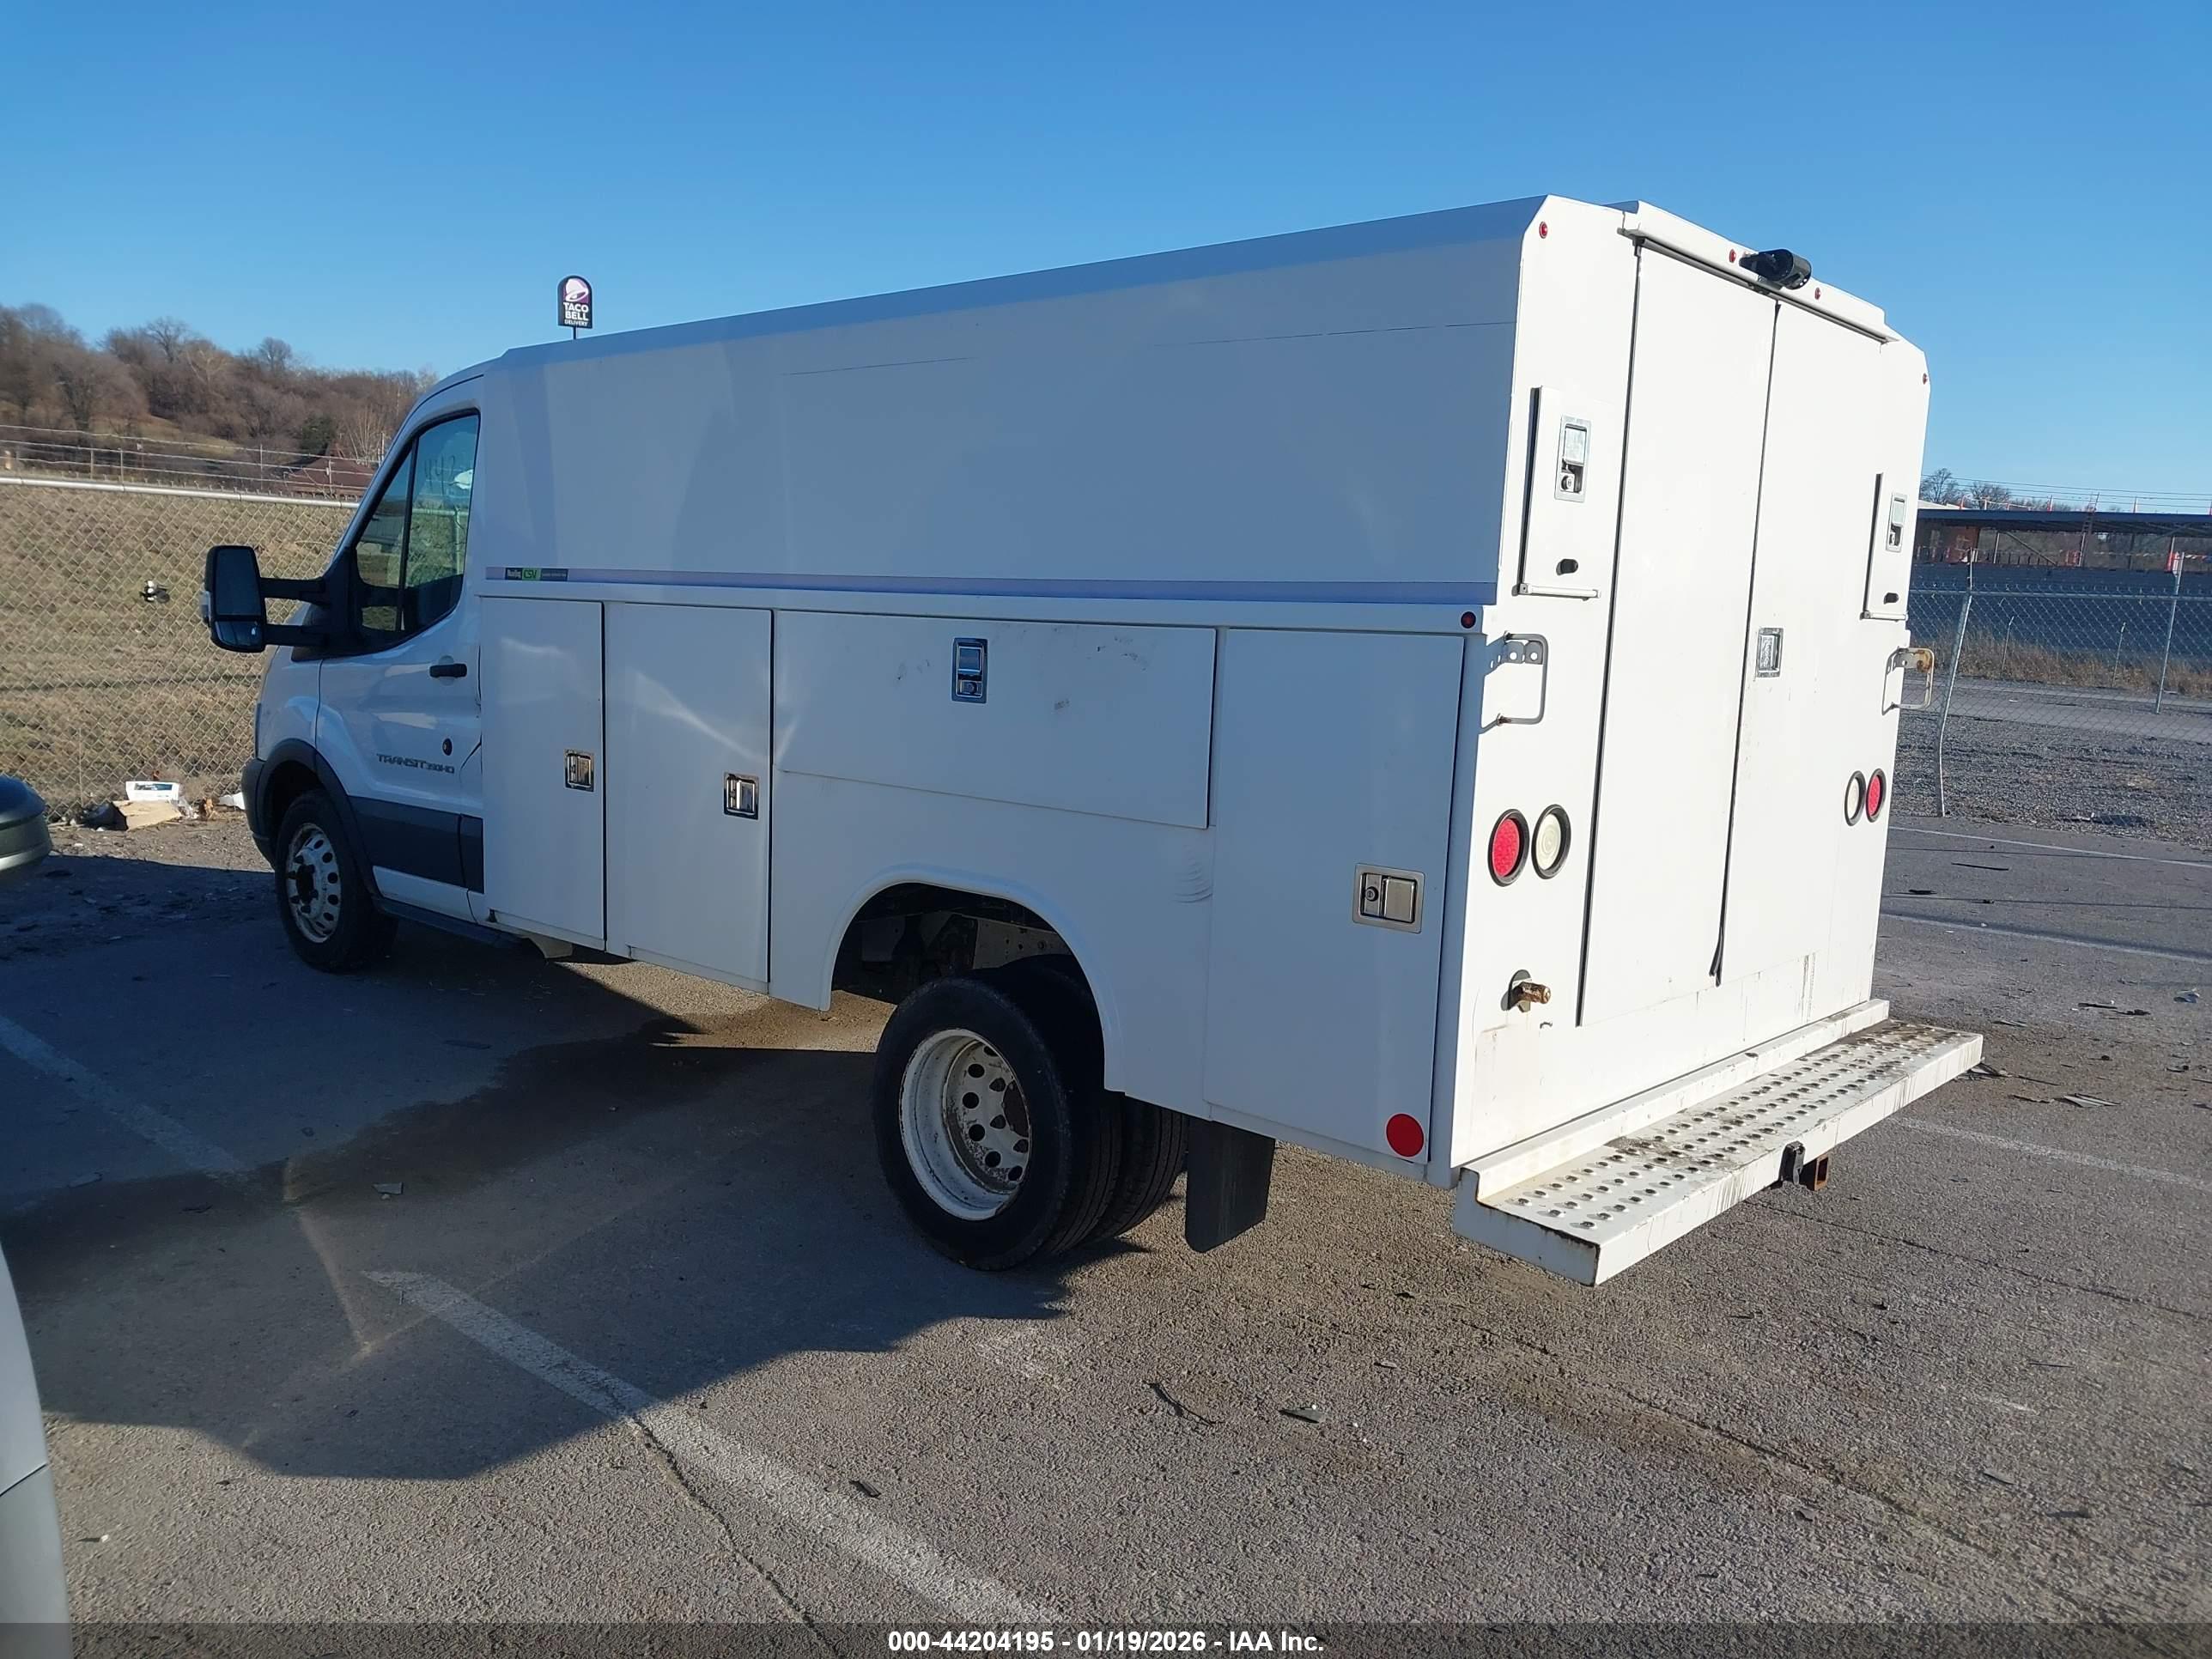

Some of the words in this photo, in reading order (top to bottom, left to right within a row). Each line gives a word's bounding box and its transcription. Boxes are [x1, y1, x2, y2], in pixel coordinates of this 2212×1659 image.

[563, 302, 589, 313] TACO
[565, 311, 589, 321] BELL
[376, 753, 427, 769] TRANSIT
